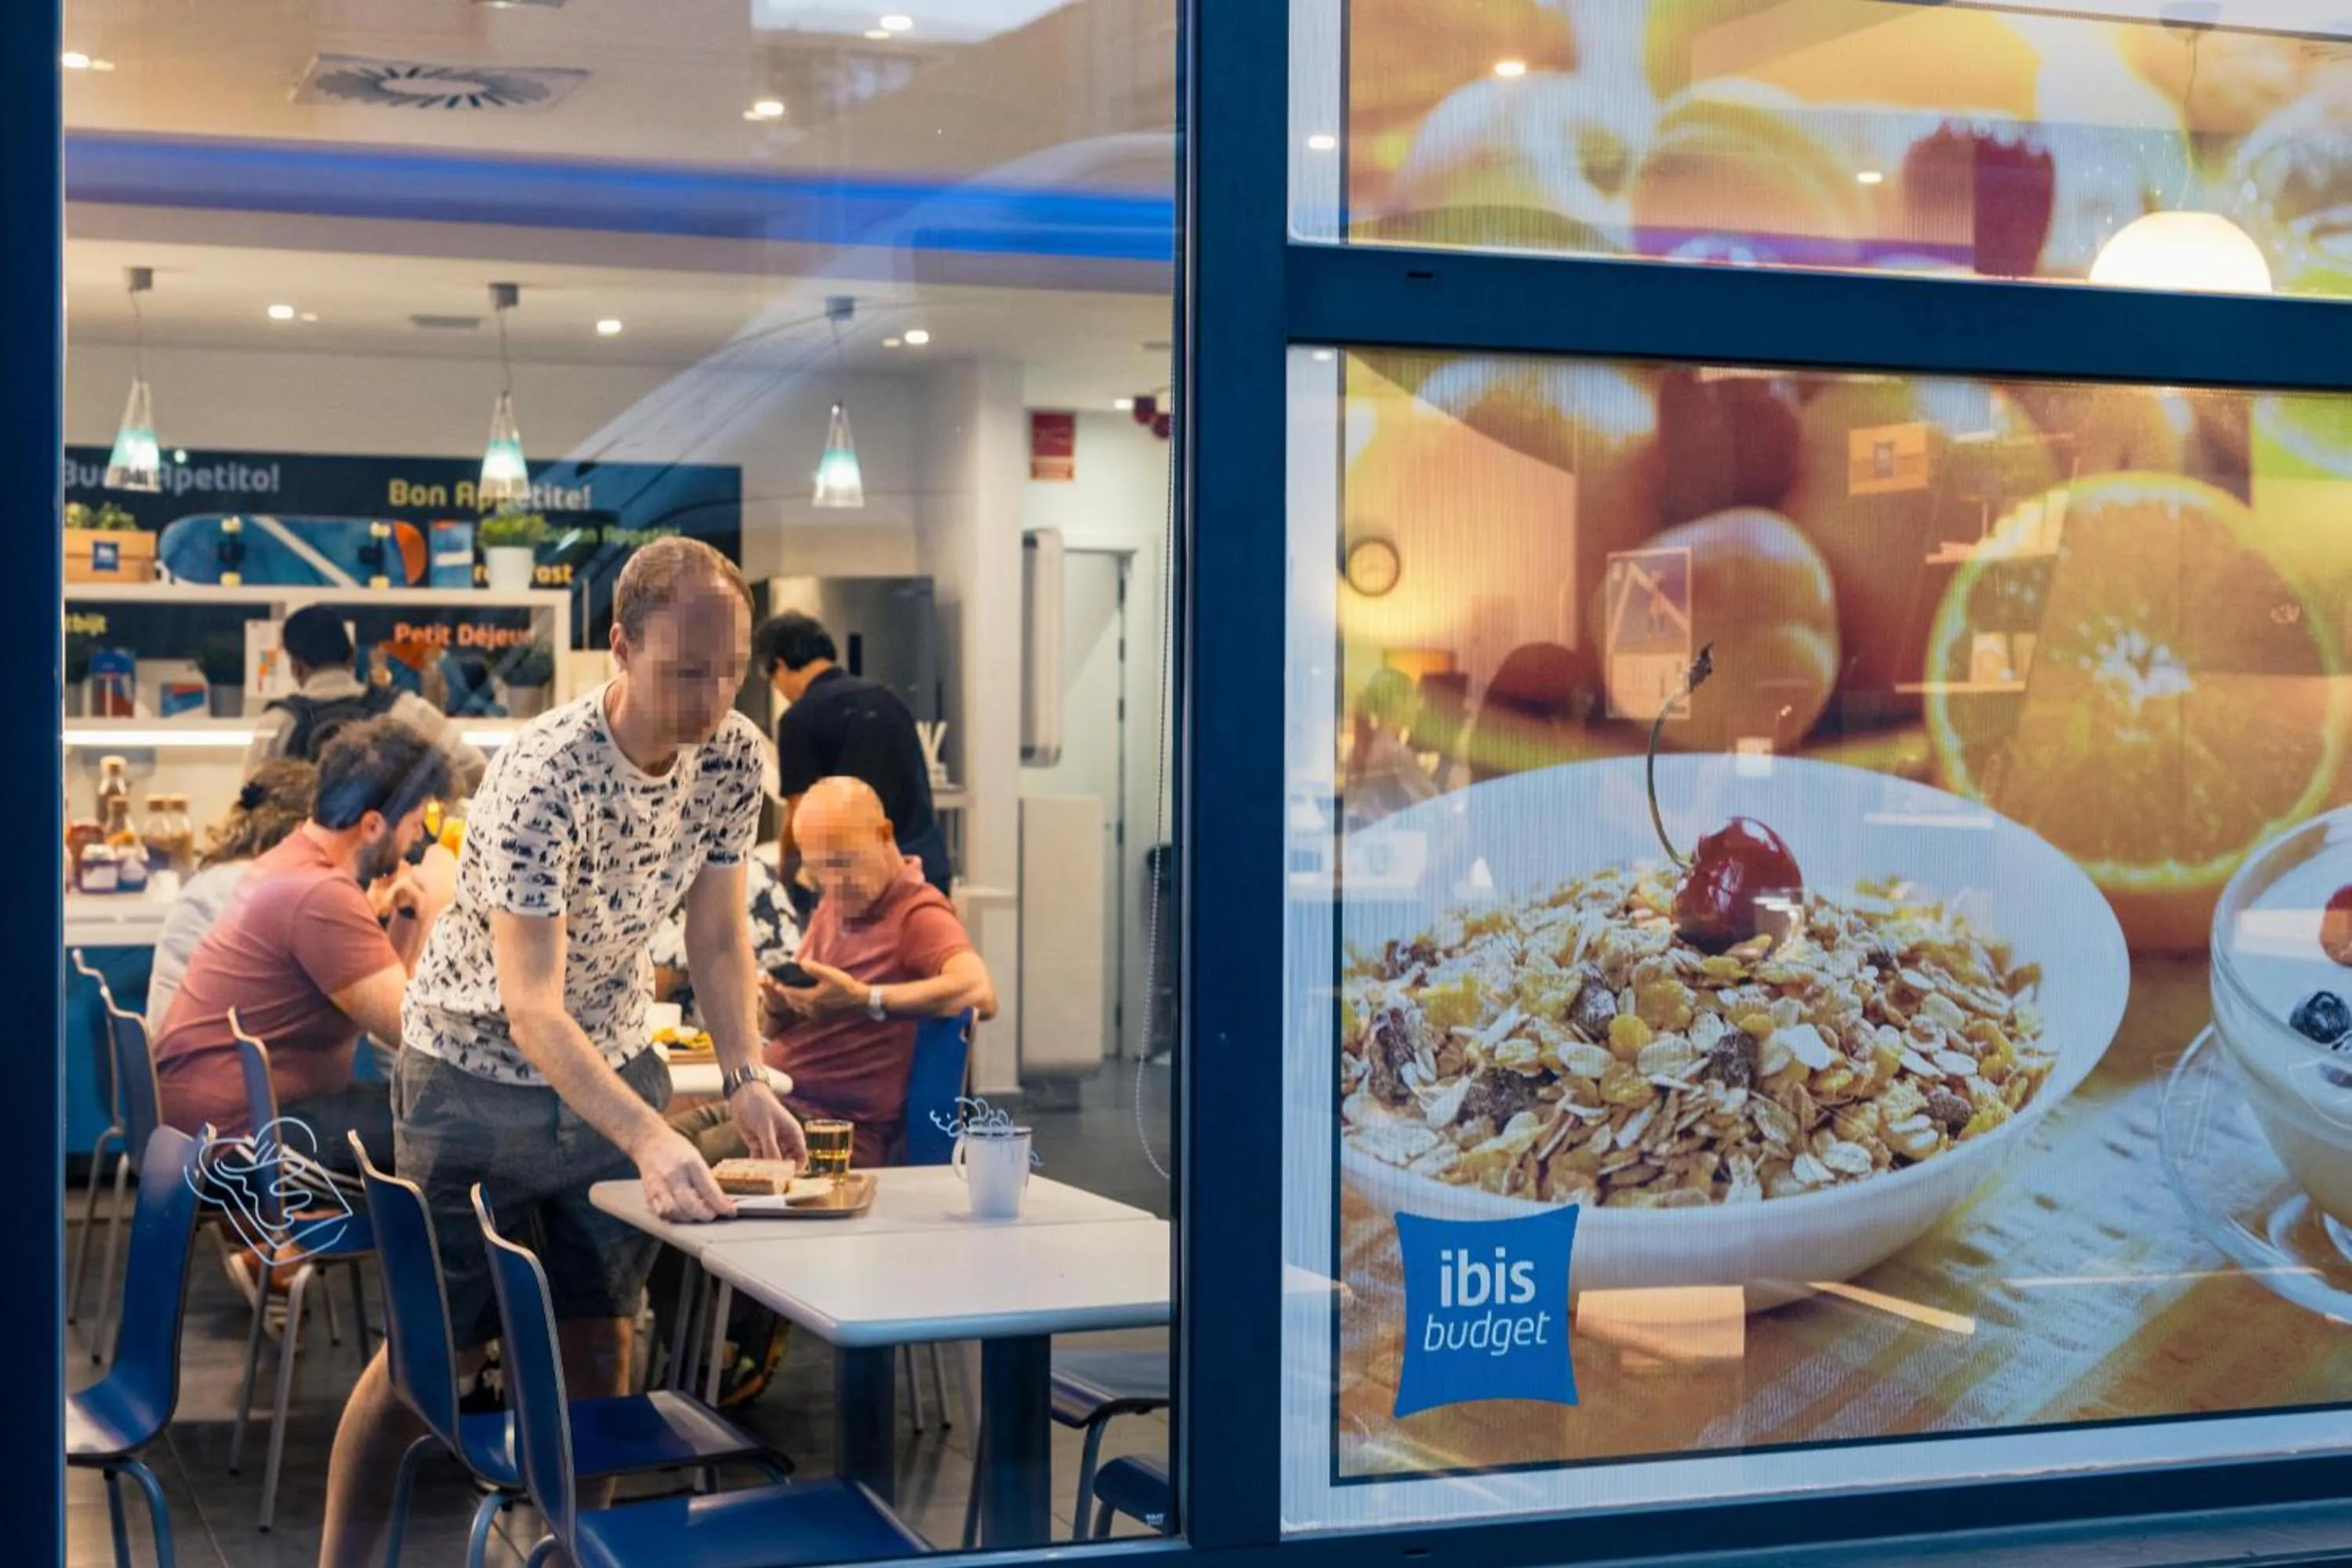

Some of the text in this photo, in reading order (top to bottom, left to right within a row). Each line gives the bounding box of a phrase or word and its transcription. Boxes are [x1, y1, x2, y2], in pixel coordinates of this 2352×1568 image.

[389, 478, 447, 507] Bon
[394, 622, 450, 647] Petit
[1439, 1247, 1537, 1308] ibis
[1423, 1310, 1552, 1356] budget
